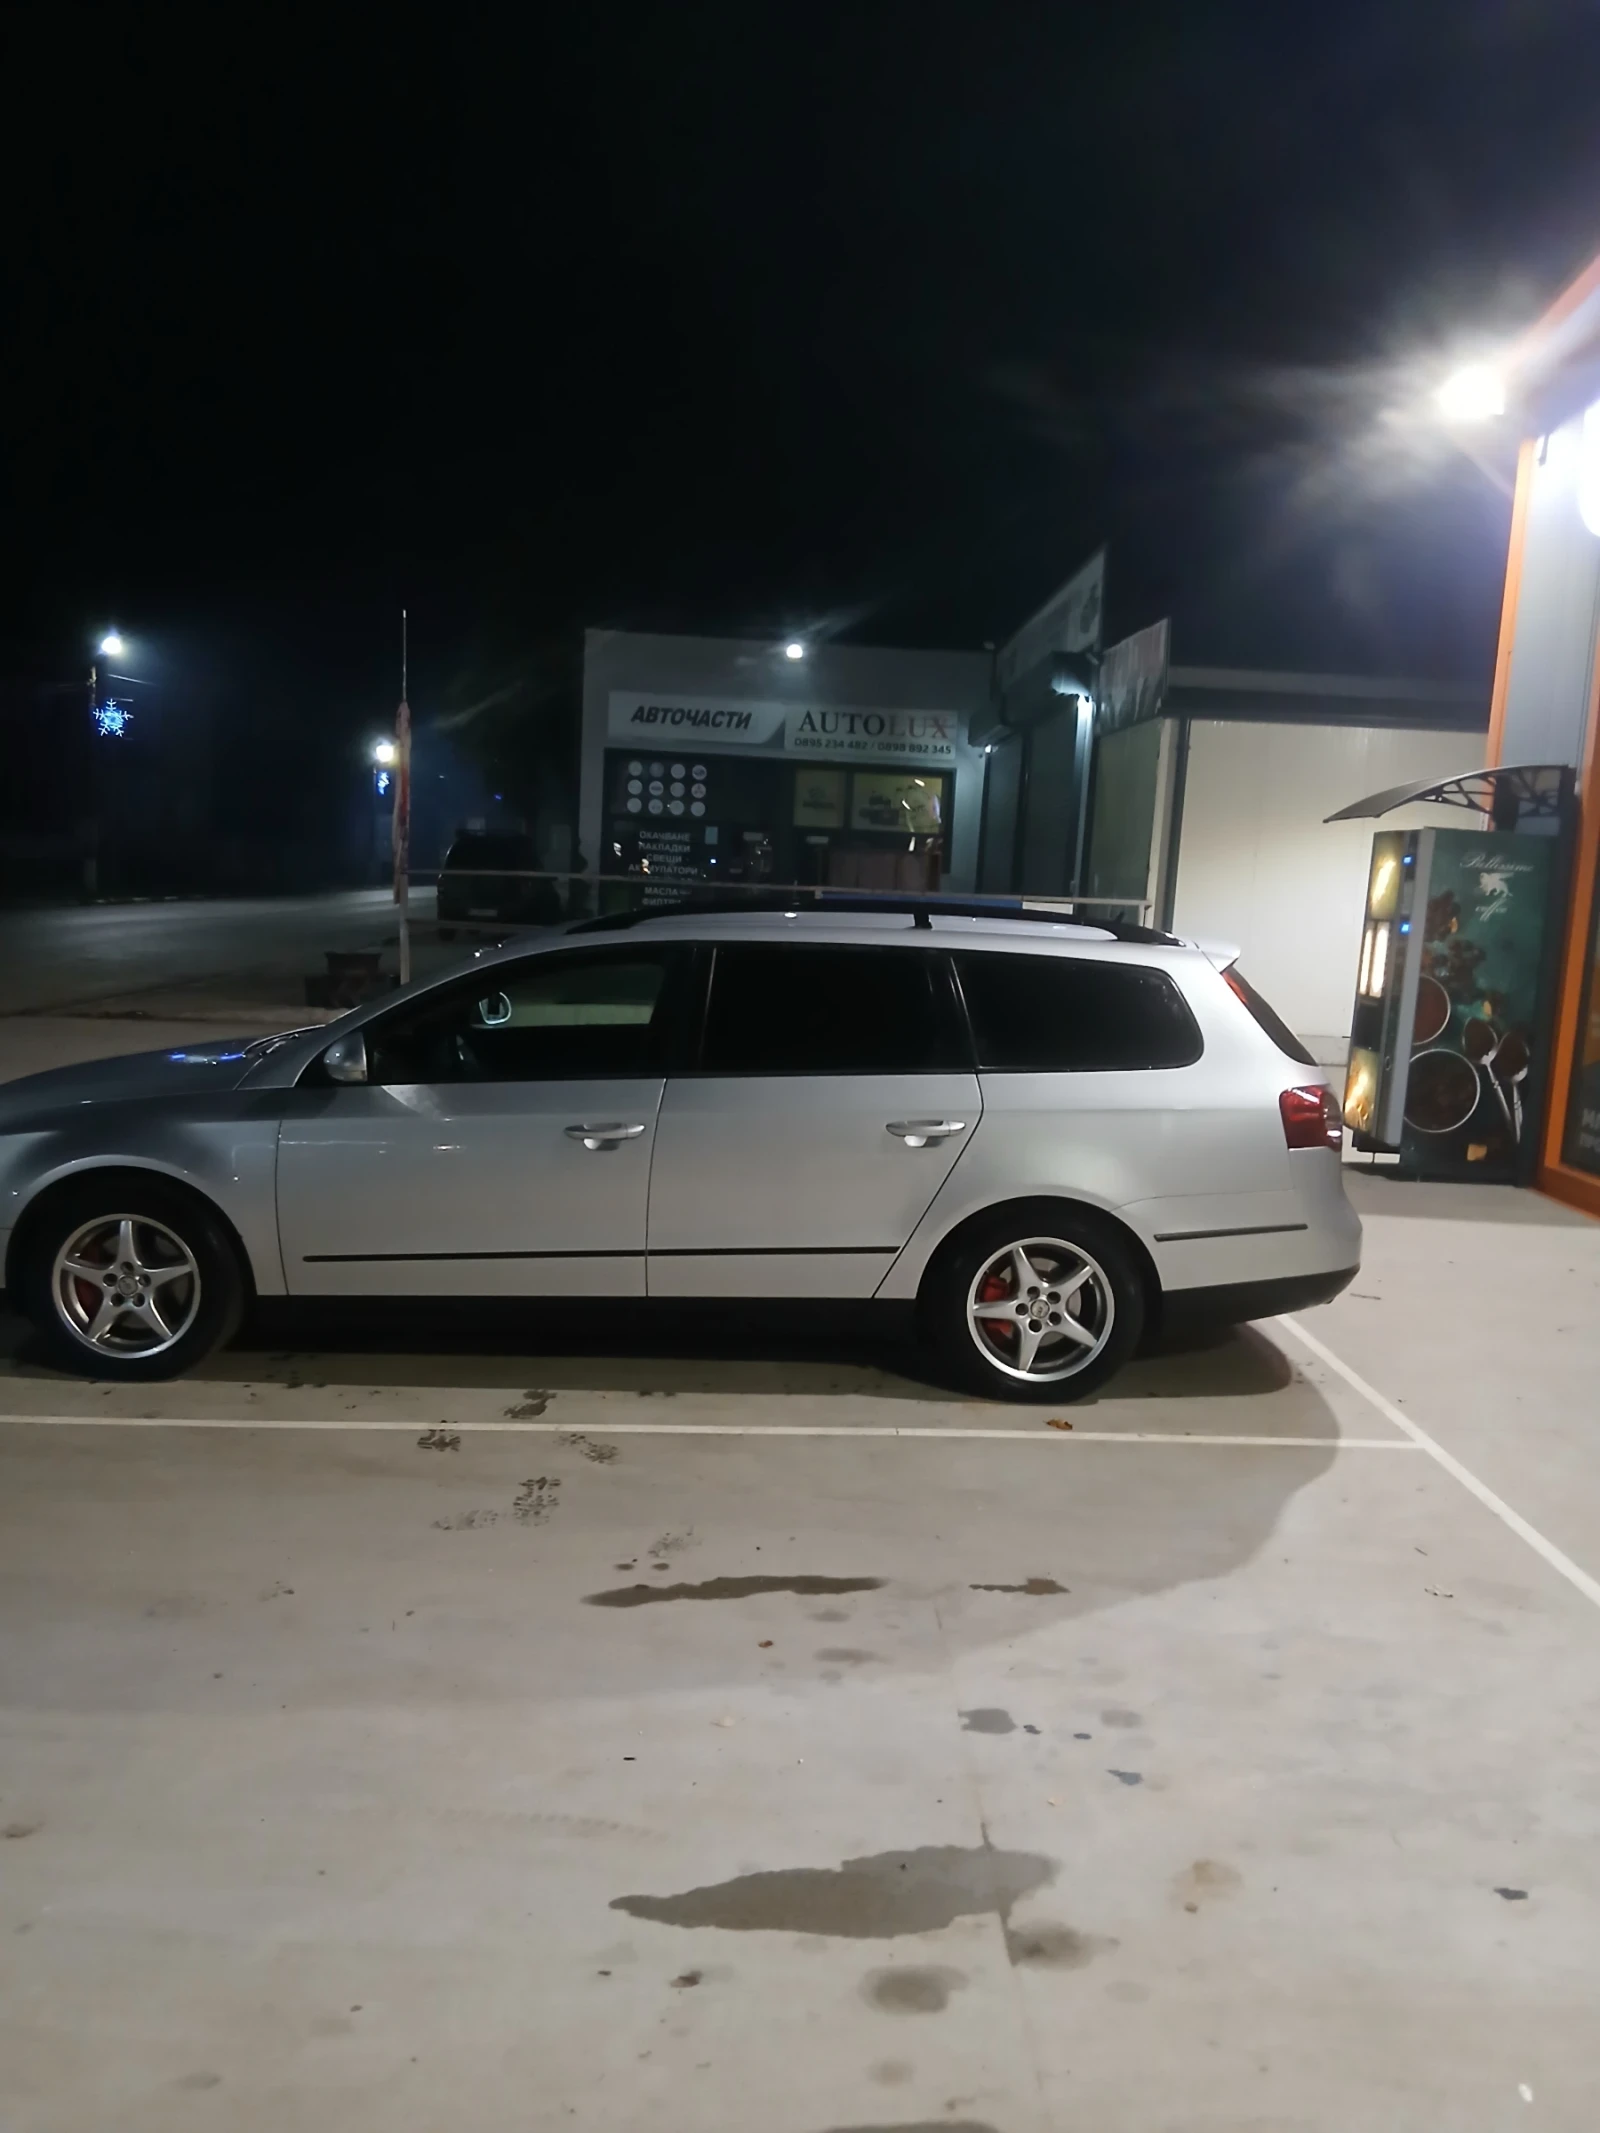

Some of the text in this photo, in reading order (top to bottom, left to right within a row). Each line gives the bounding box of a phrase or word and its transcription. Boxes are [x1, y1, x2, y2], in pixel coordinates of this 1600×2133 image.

[630, 705, 752, 730] АВТОЧАСТИ
[798, 709, 949, 740] AUTOLUX
[794, 737, 823, 749] 0895
[824, 738, 845, 749] 234
[931, 744, 952, 755] 345
[639, 830, 691, 842] ОКАЧВАНЕ
[638, 842, 691, 853] НАКЛАДКИ
[646, 853, 682, 864] СВЕЩИ
[628, 863, 698, 876] АКМУЛАТОРИ
[644, 886, 679, 896] МАСЛА
